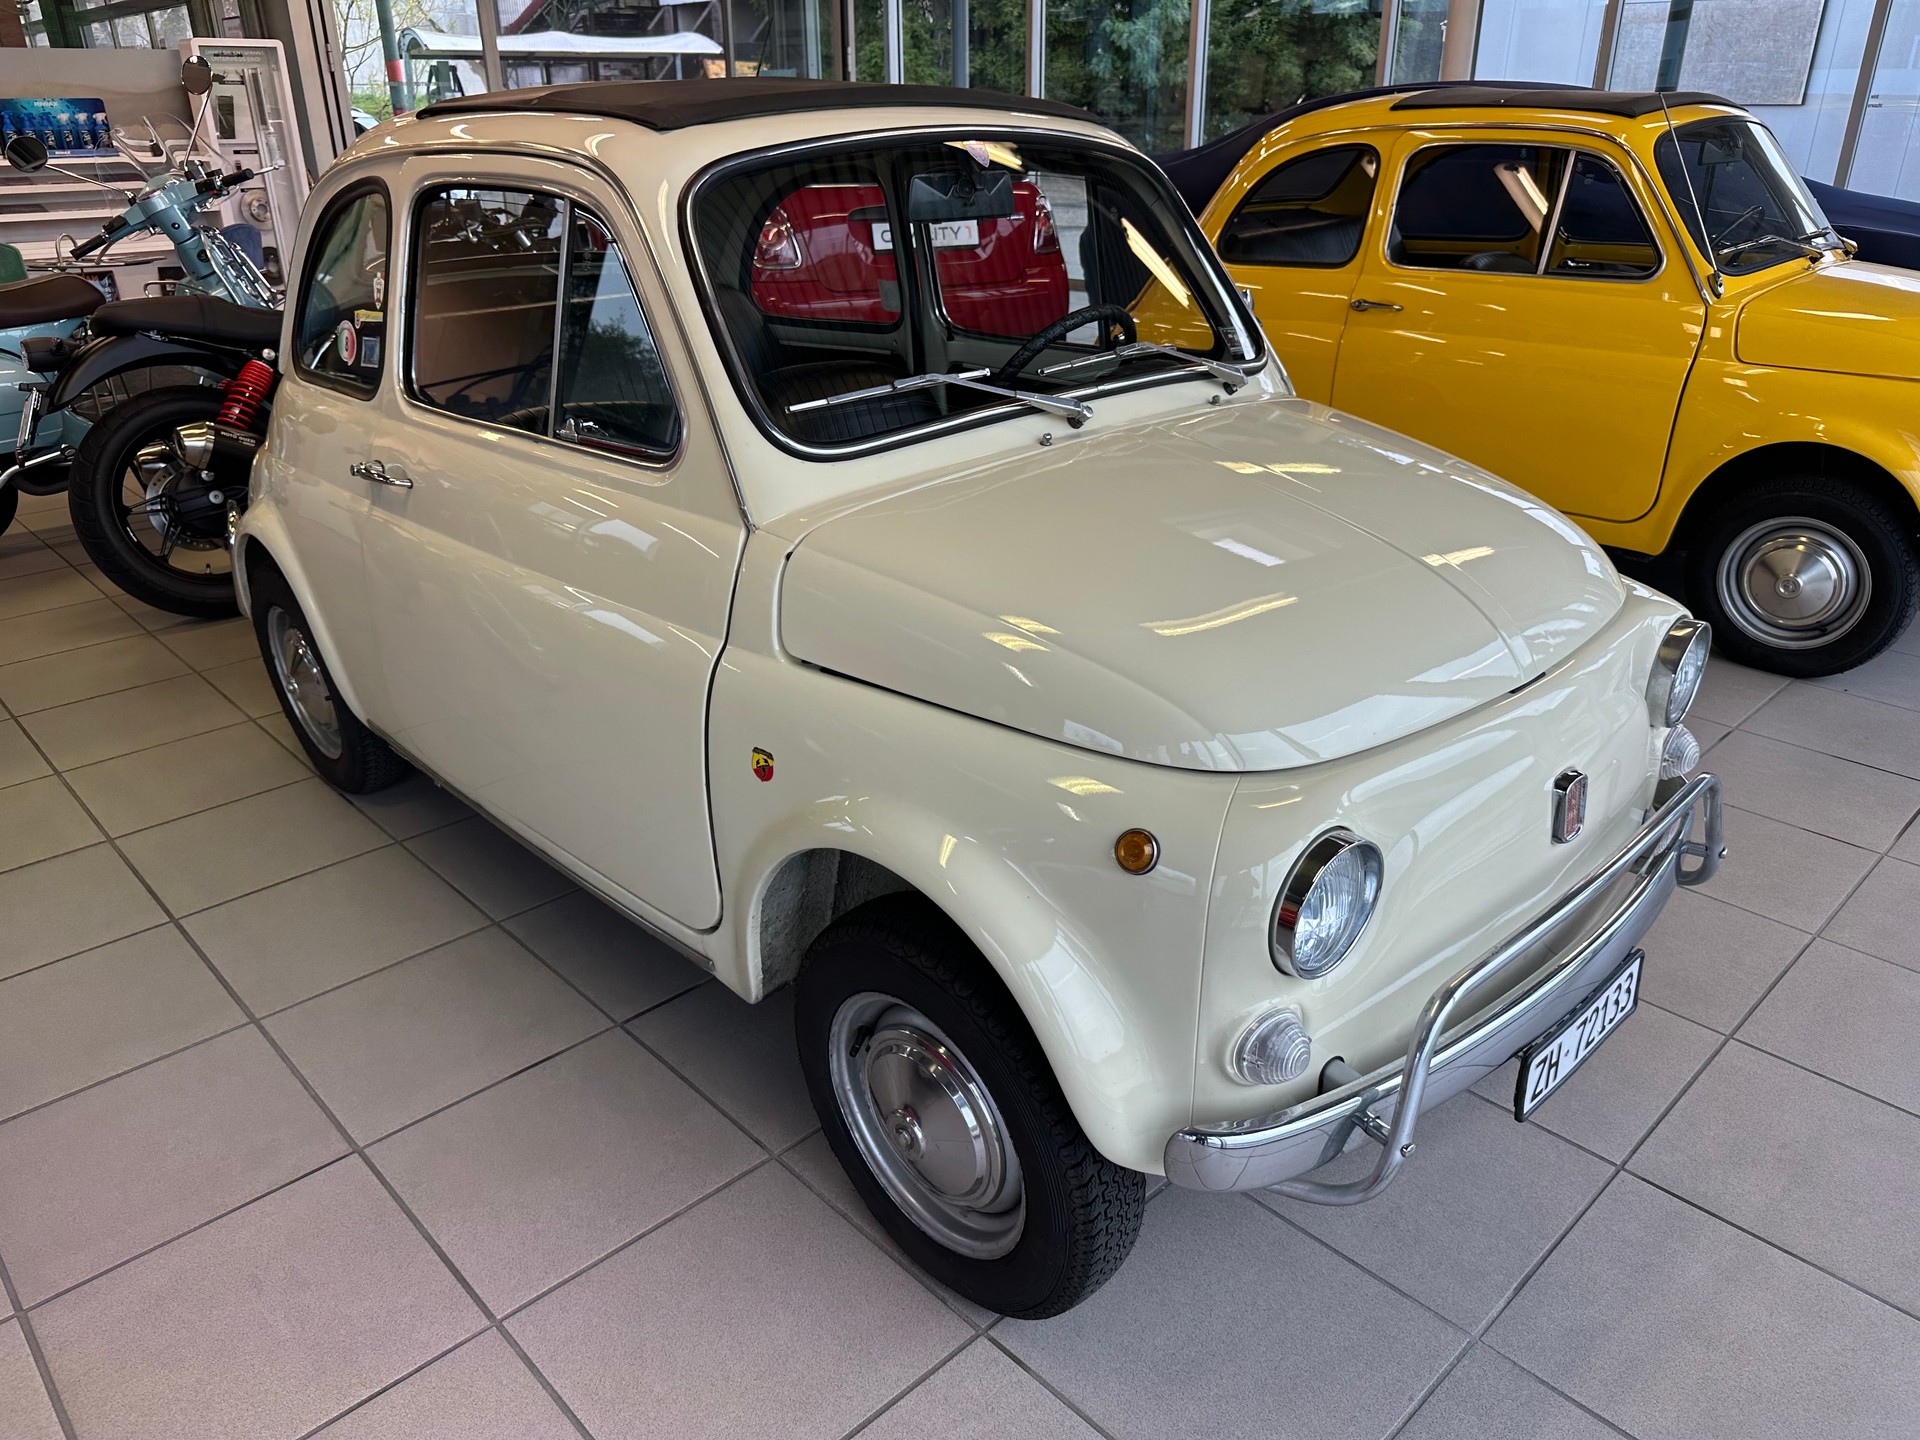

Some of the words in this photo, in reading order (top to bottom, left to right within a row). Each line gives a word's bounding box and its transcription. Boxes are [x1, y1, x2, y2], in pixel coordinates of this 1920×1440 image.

[220, 431, 238, 439] MOTO
[1530, 1042, 1563, 1104] ZH
[1573, 971, 1634, 1062] 72133
